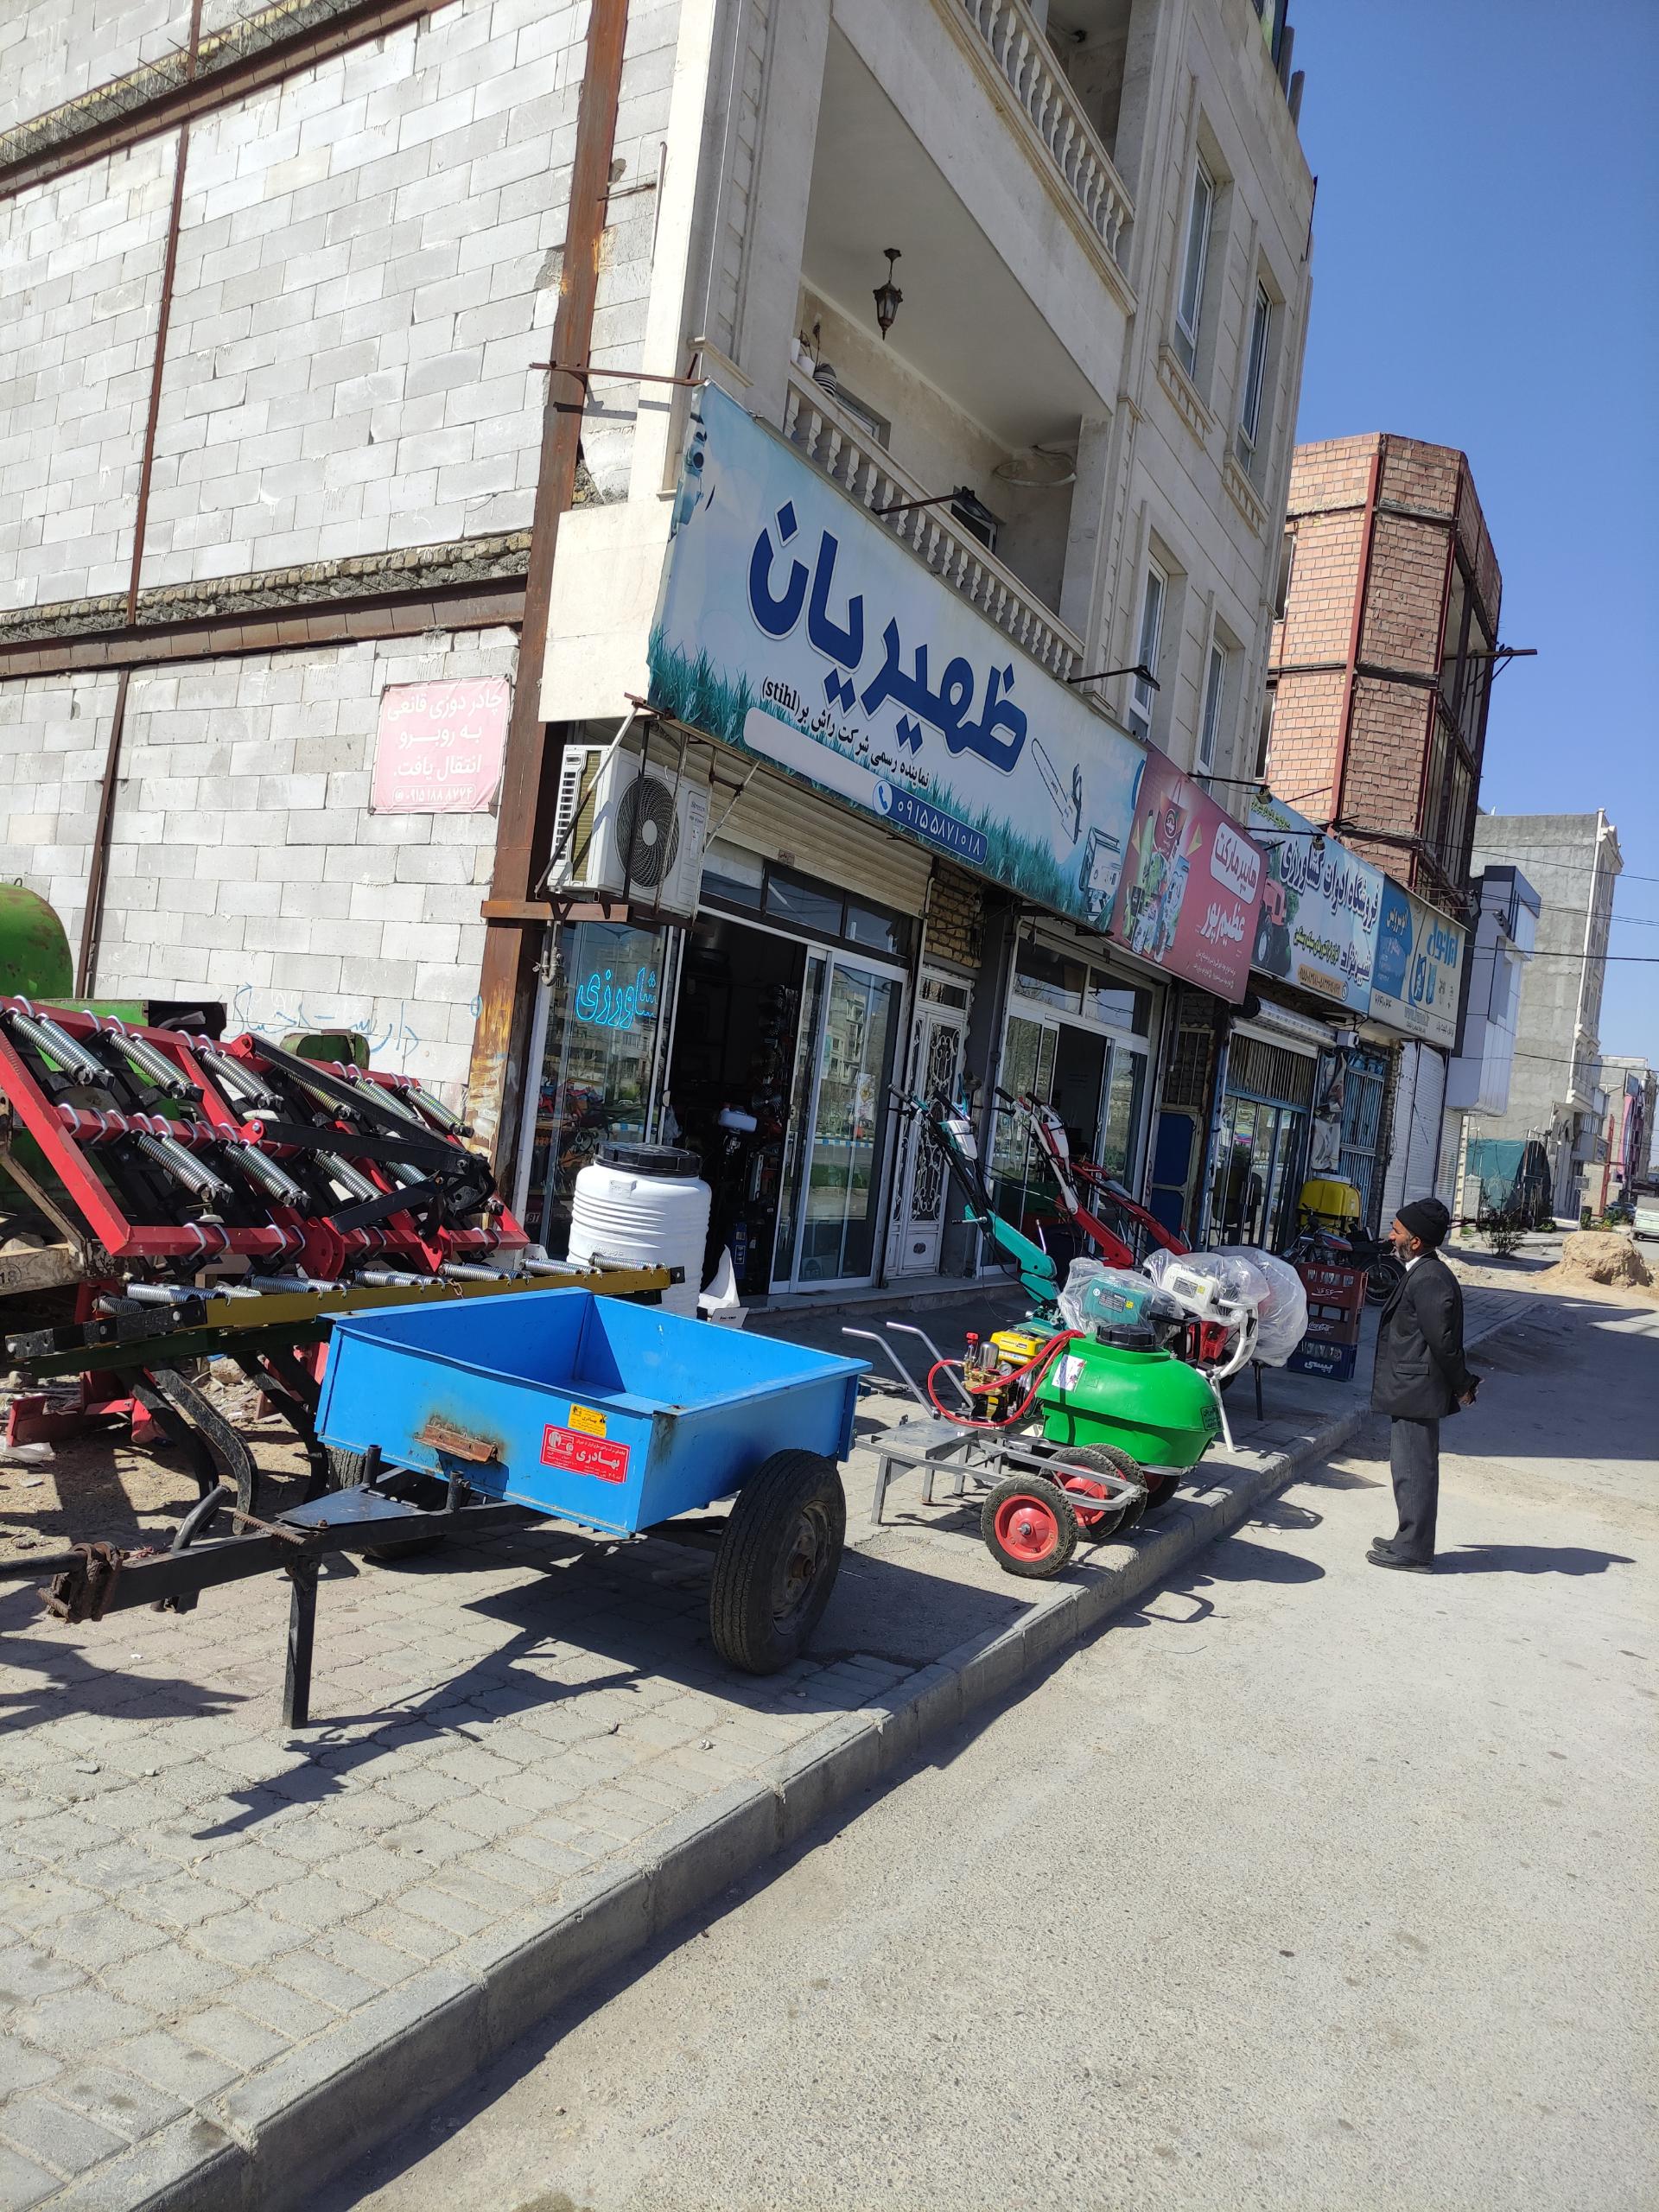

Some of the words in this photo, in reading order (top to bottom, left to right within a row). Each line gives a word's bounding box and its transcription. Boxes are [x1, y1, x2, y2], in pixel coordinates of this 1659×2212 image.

[748, 499, 1027, 773] ظهیریان
[388, 693, 427, 721] قانعی
[429, 694, 467, 720] دوزی
[468, 689, 504, 717] چادر
[460, 725, 483, 744] به
[811, 709, 836, 733] راش
[399, 728, 456, 749] روبرو
[838, 727, 869, 757] شرکت
[436, 753, 483, 782] انتقال
[870, 751, 898, 773] رسمی
[899, 761, 929, 788] نماینده
[1215, 832, 1258, 894] هایپرمارکت
[1280, 840, 1325, 895] کشاورزی
[1323, 858, 1351, 915] ادوات
[1348, 871, 1380, 933] فروشگاه
[575, 1450, 620, 1471] بهادری
